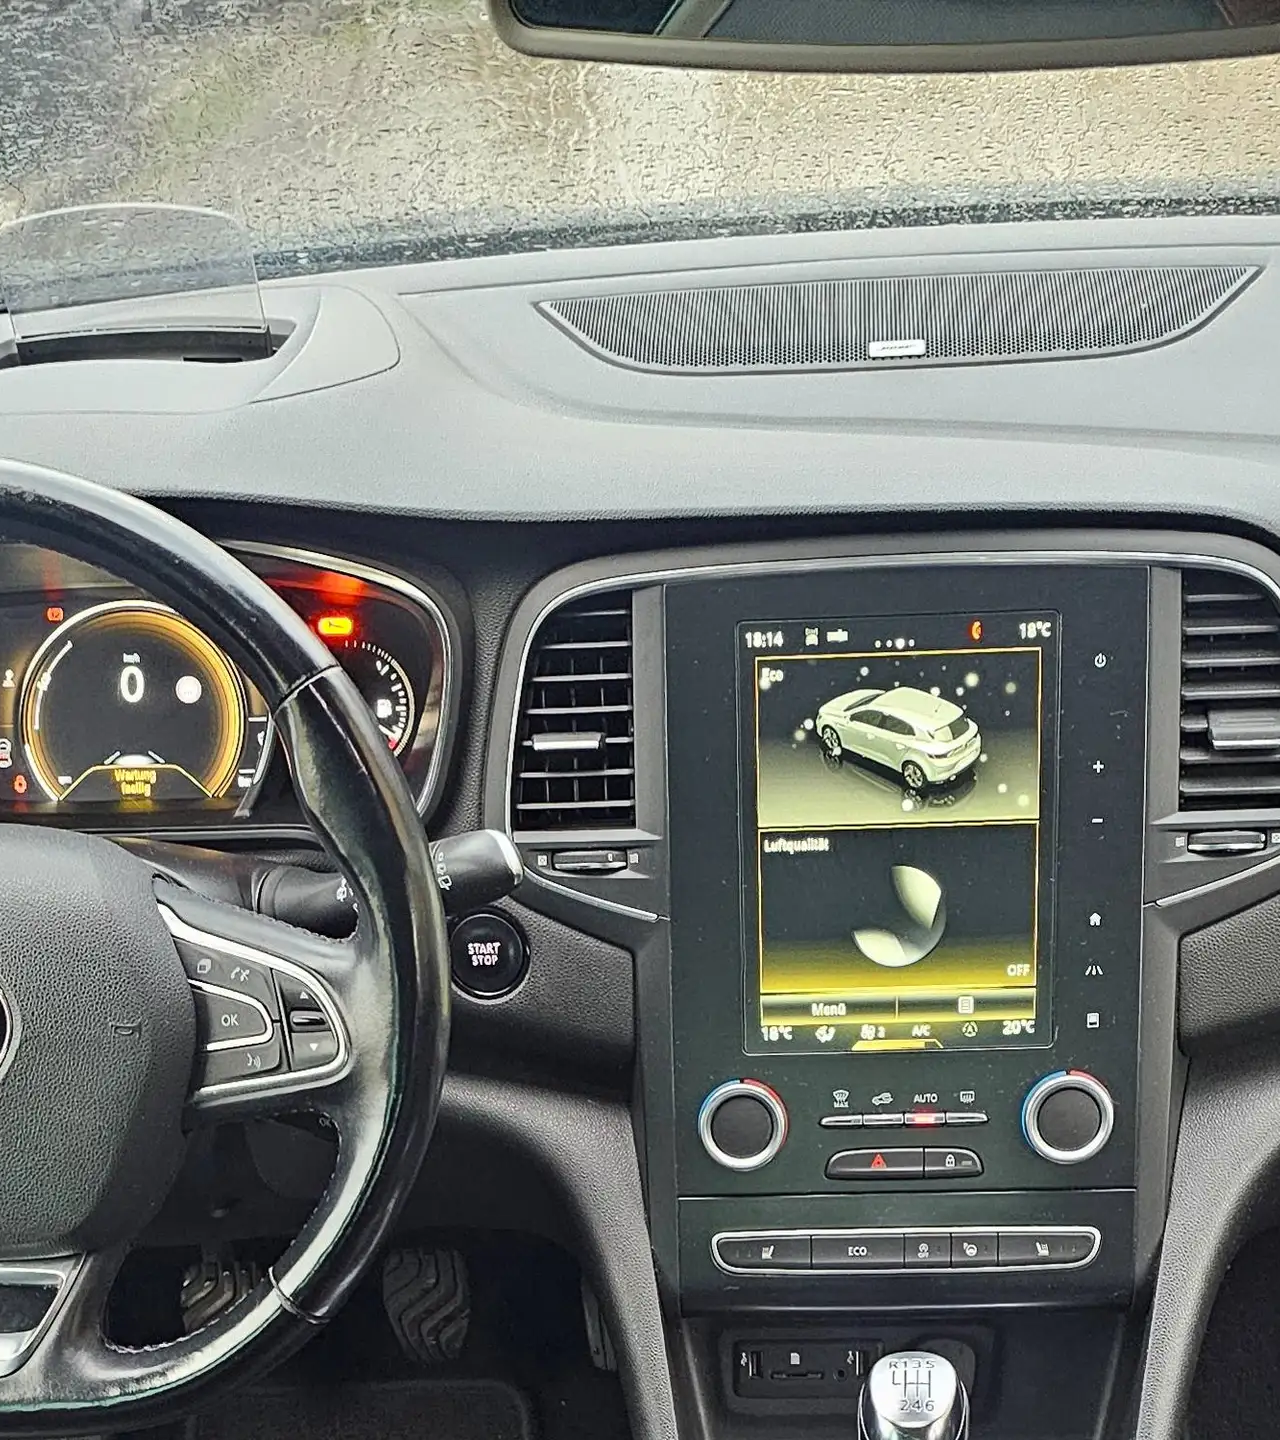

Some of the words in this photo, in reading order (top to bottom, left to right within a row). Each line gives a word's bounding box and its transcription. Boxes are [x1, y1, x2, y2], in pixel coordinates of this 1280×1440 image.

[745, 631, 783, 648] 18:14
[120, 665, 144, 703] 0
[467, 942, 501, 955] START
[471, 954, 499, 967] STOP
[1007, 963, 1031, 977] OFF
[221, 1013, 239, 1026] OK
[913, 1093, 938, 1104] AUTO
[847, 1246, 868, 1256] ECO
